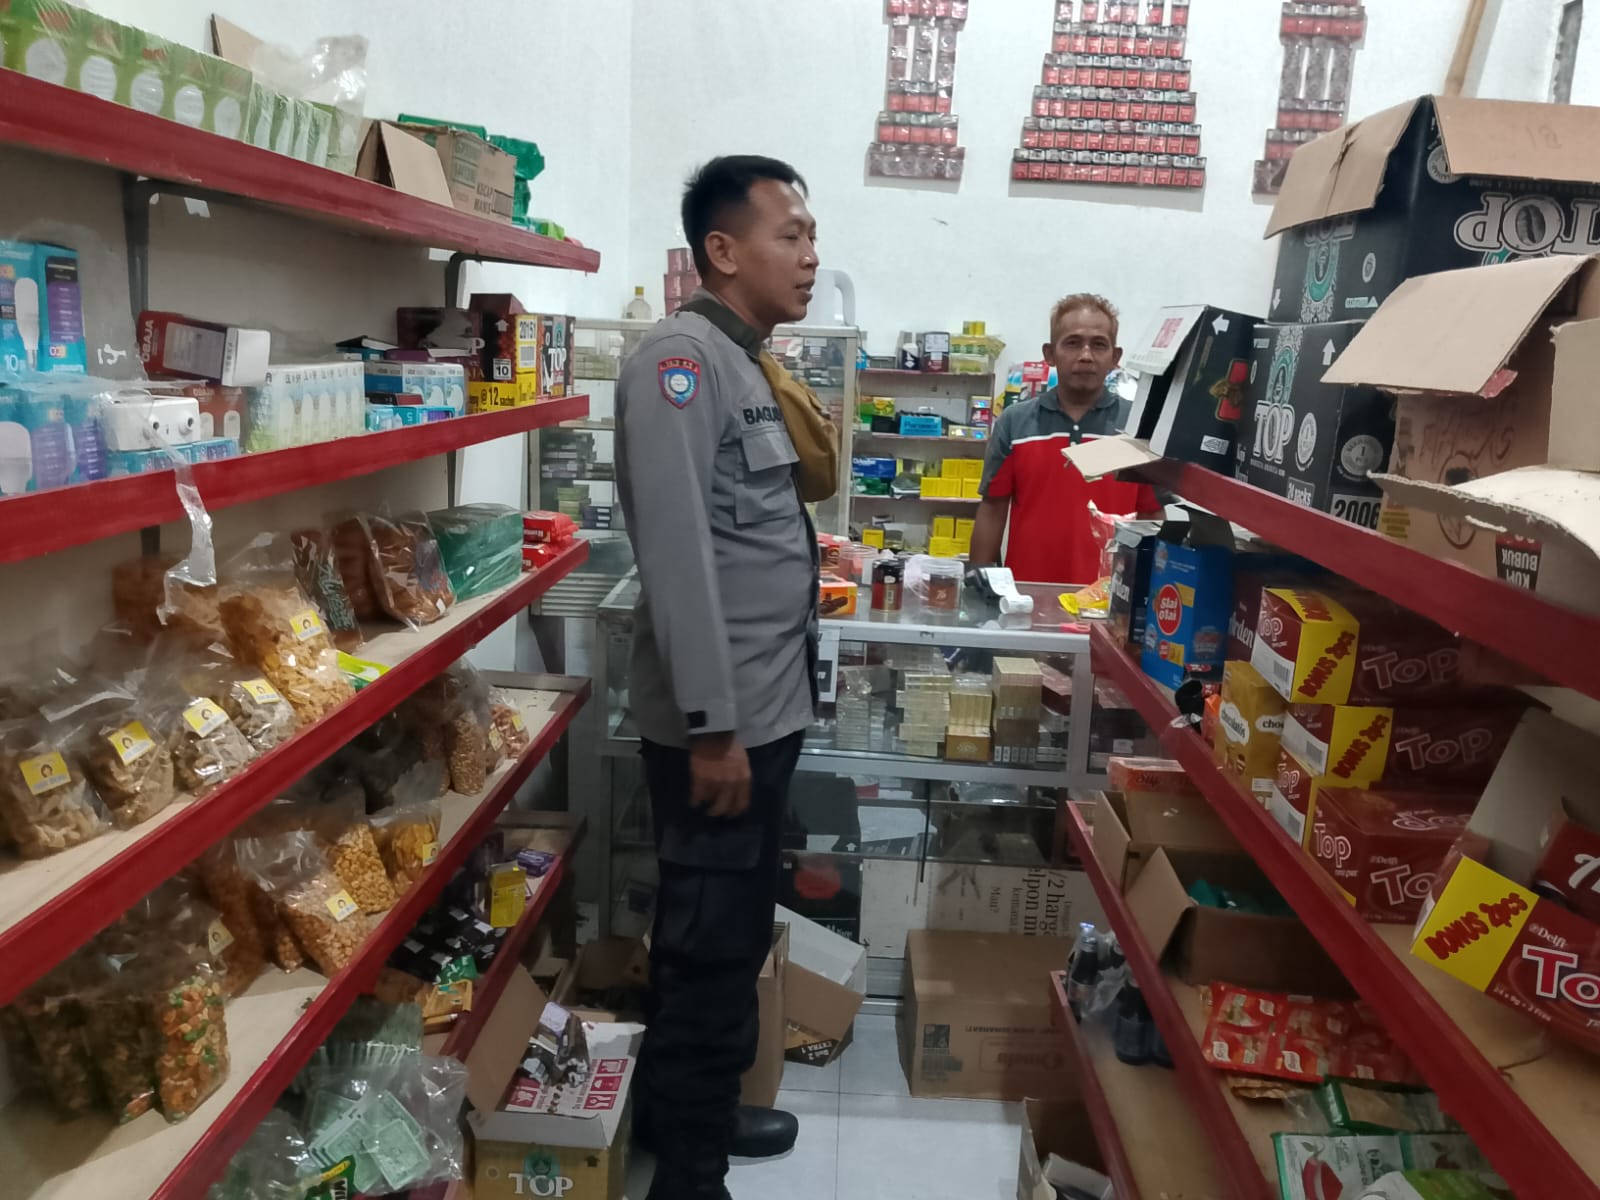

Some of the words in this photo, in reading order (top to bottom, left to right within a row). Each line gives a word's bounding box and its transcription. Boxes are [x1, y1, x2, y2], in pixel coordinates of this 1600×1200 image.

[495, 365, 510, 377] 10
[1252, 399, 1295, 465] TOP
[1501, 548, 1538, 572] BUBUK
[1297, 656, 1338, 698] BONUS
[1331, 738, 1372, 779] BONUS
[1314, 823, 1352, 868] Top
[1370, 863, 1441, 906] To
[1424, 911, 1489, 960] BONUS
[1522, 944, 1600, 1009] To
[508, 1173, 574, 1197] TOP
